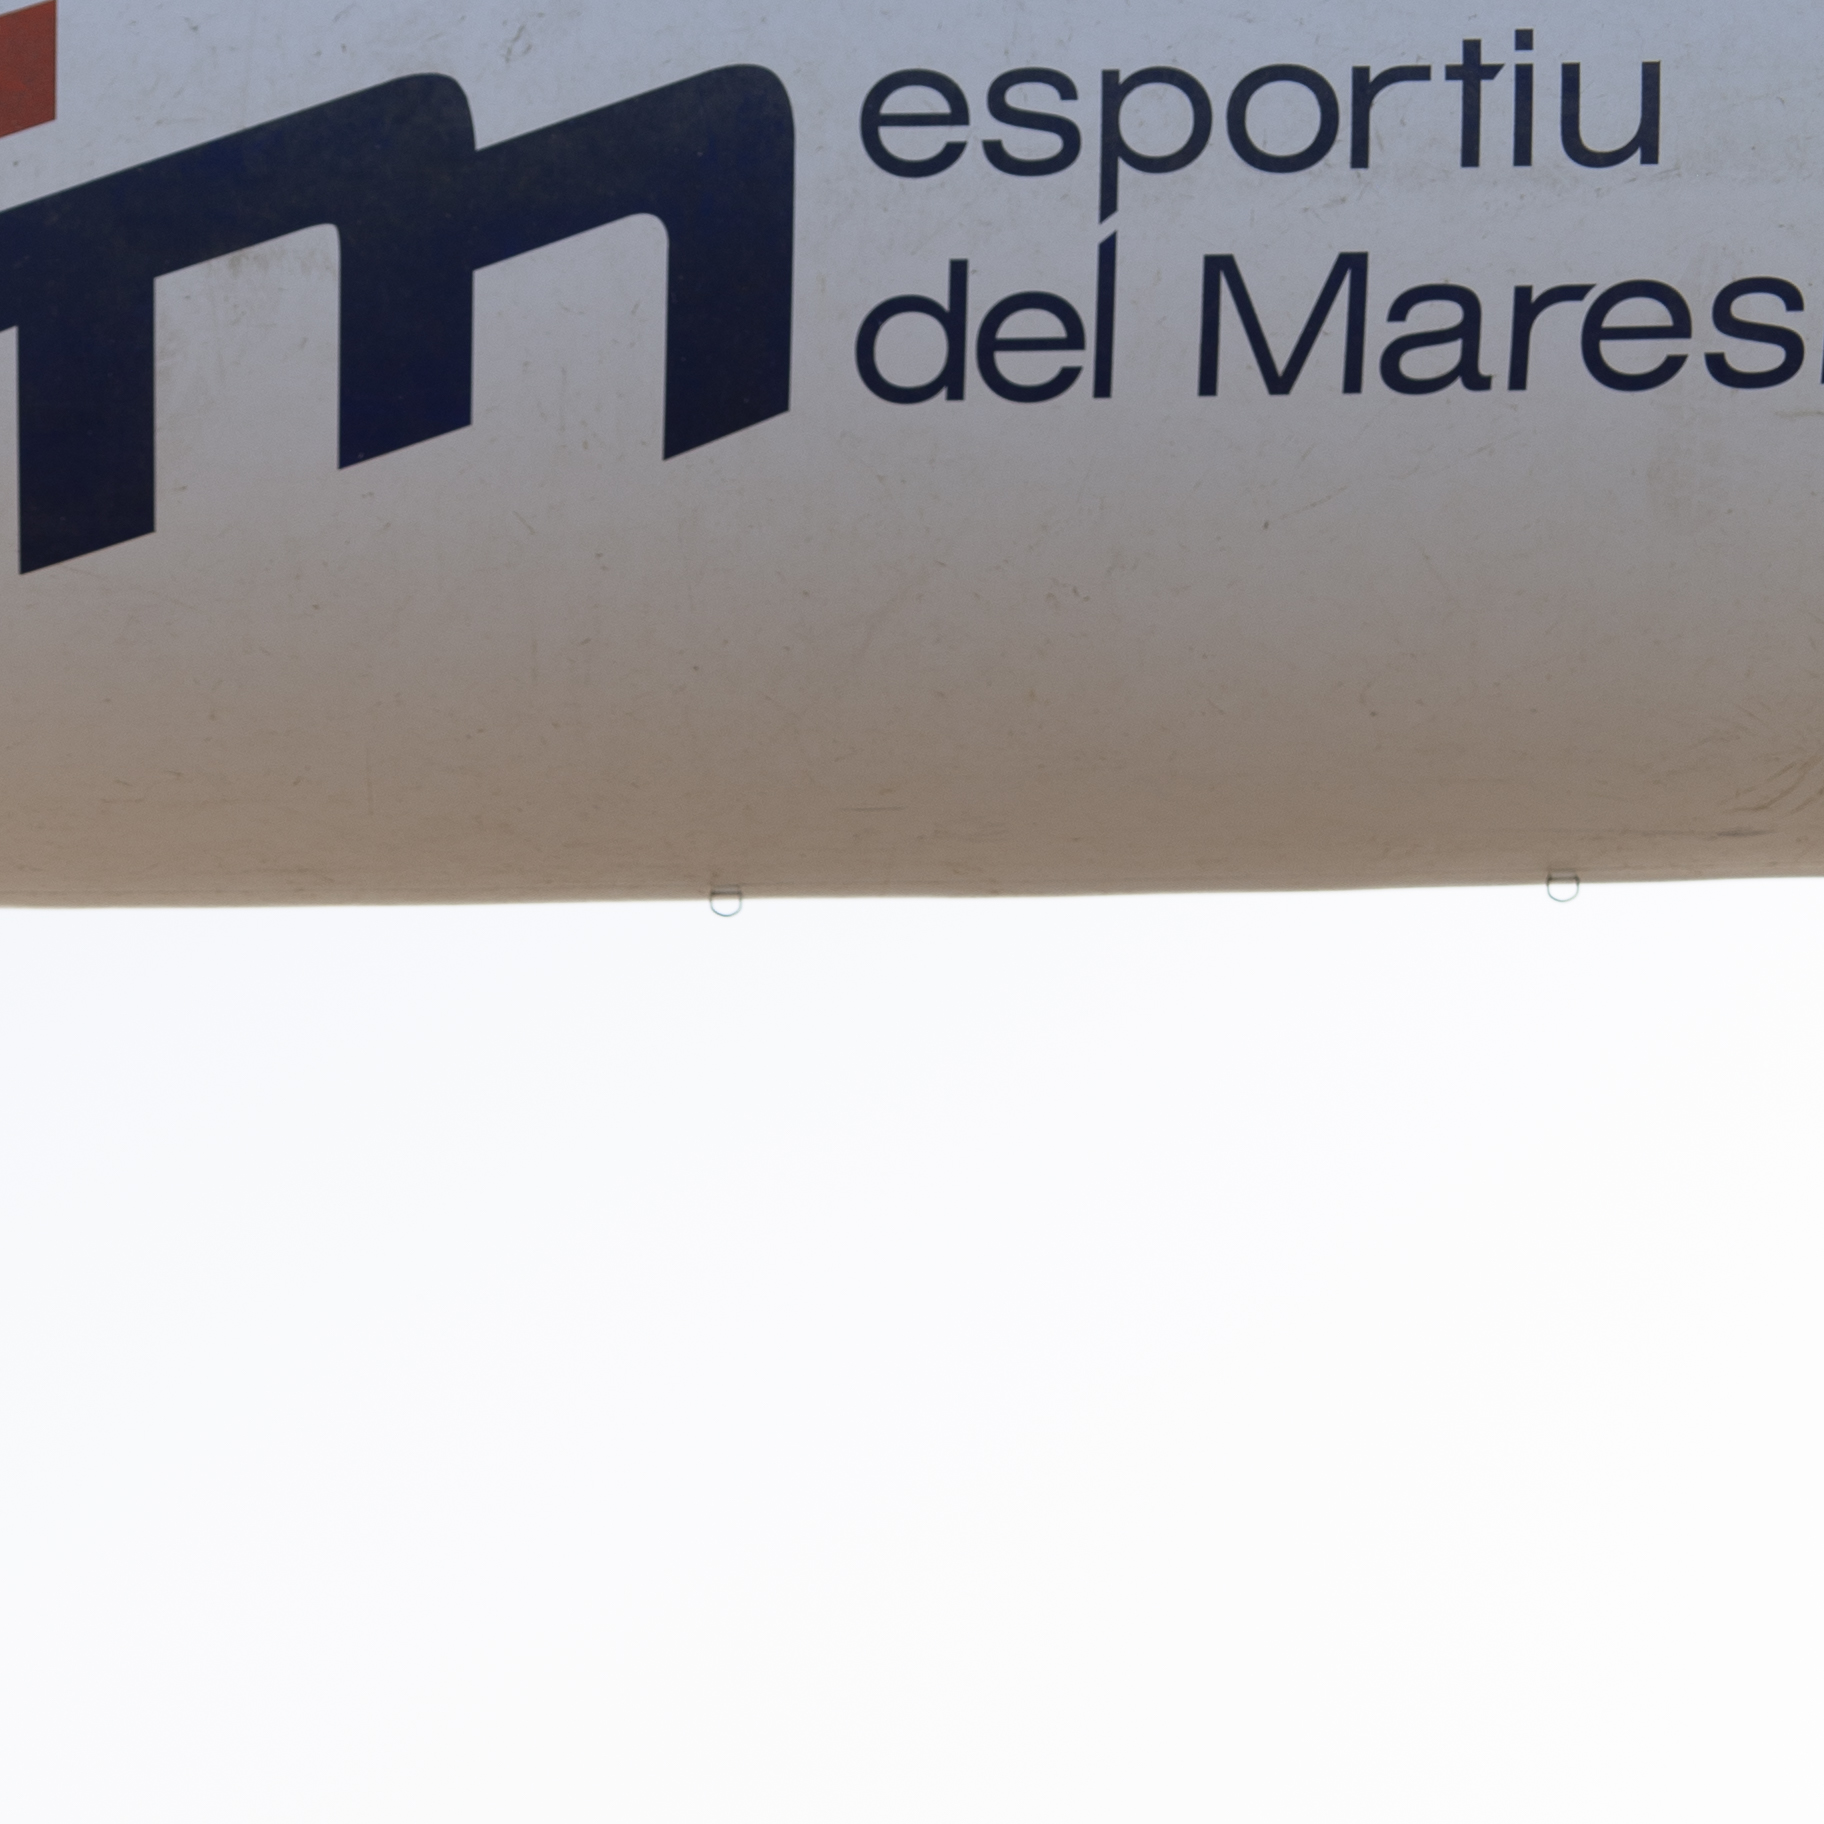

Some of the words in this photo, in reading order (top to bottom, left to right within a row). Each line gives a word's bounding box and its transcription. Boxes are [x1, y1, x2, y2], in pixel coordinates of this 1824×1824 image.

[859, 28, 1662, 225] esportiu
[855, 229, 1118, 404] del
[1197, 251, 1824, 397] Mares
